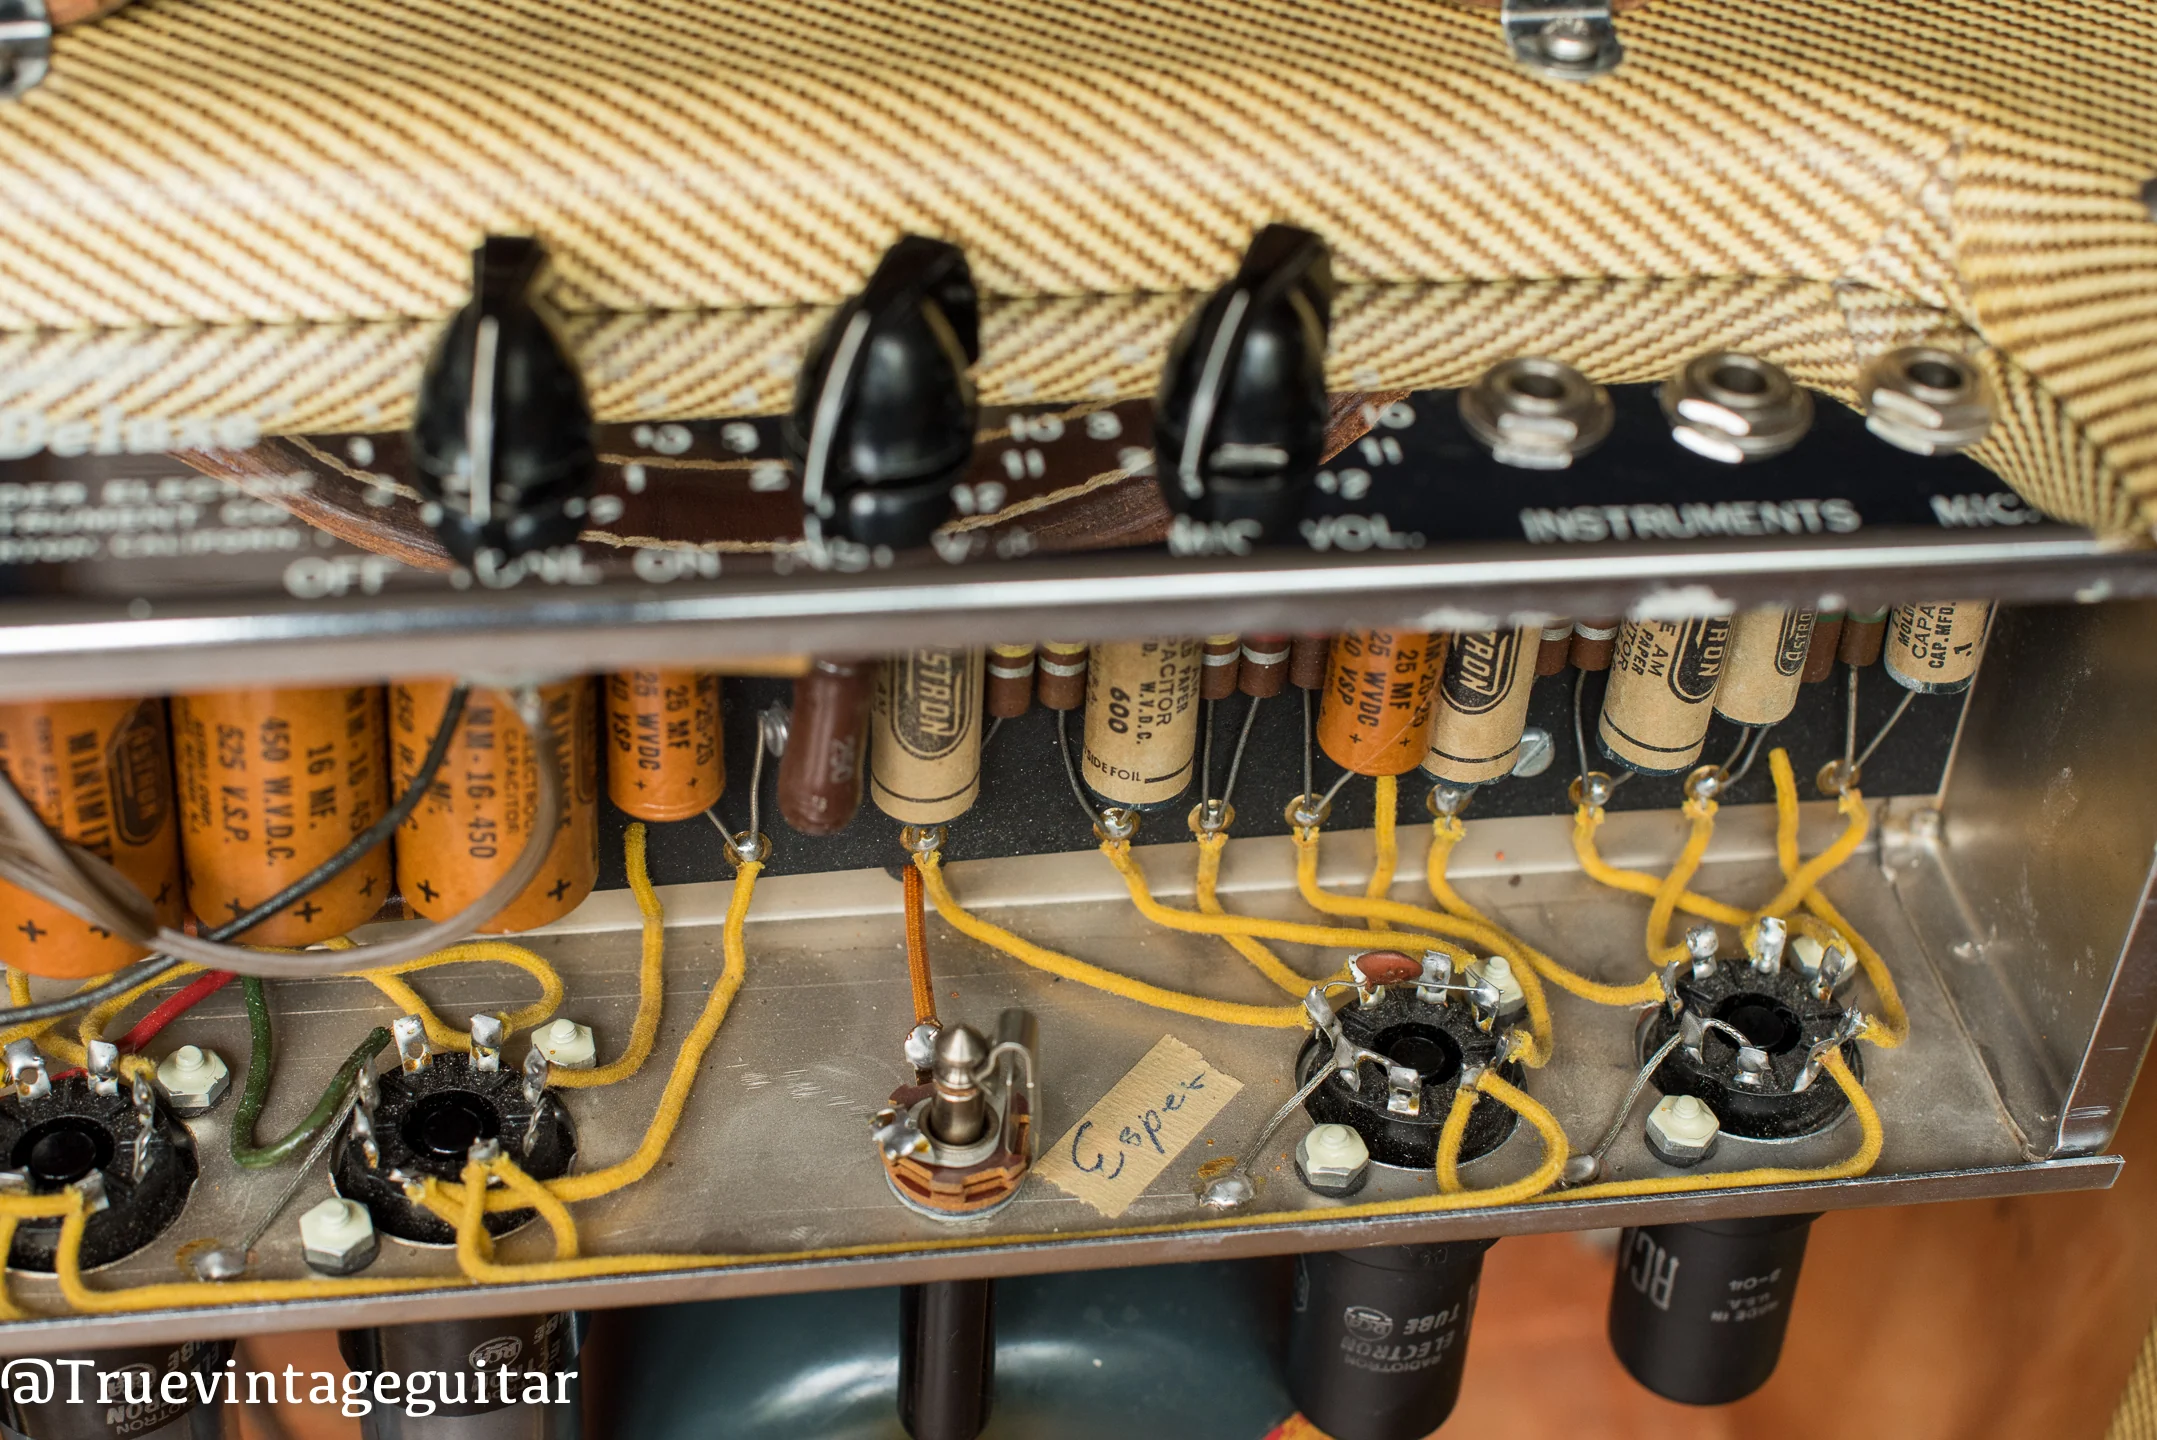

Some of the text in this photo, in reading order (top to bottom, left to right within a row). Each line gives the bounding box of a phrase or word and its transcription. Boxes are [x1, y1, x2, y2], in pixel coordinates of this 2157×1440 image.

[1519, 497, 1862, 544] INSTRUMENTS
[1631, 627, 1655, 677] PAPER
[1646, 642, 1670, 678] AM
[1336, 666, 1360, 706] VSP
[1357, 629, 1393, 728] 25 WVDC
[1389, 649, 1419, 711] 25 MF
[613, 711, 632, 753] VSP
[664, 684, 692, 751] 25 MF
[1108, 686, 1132, 735] 600
[1134, 681, 1157, 746] W.V.D.C.
[216, 723, 248, 769] 525
[260, 716, 293, 763] 450
[306, 741, 337, 776] 16
[636, 712, 663, 772] WVDC
[503, 728, 520, 837] CAPACITOR
[1109, 766, 1142, 782] FOIL
[1402, 1301, 1461, 1337] TUBE
[1339, 1328, 1456, 1362] ELECTRON
[1342, 1350, 1443, 1373] RADIOTRON
